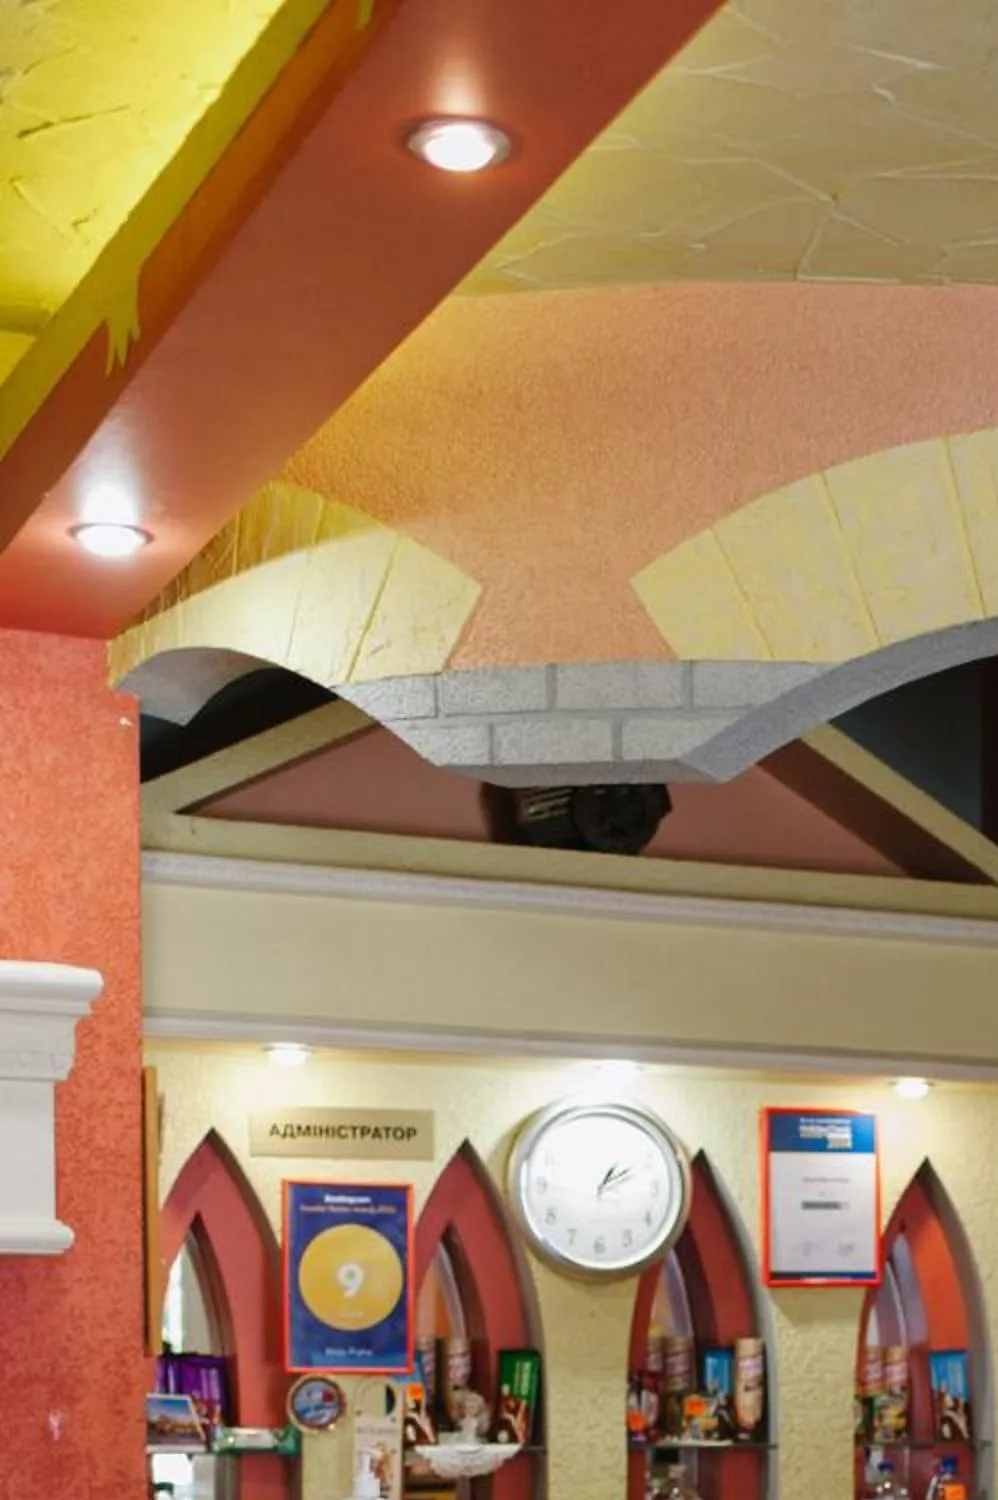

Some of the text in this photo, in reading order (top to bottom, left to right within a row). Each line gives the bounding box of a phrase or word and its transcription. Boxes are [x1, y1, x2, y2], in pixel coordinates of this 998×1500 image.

[269, 1123, 418, 1141] АДМІНІСТРАТОР
[567, 1228, 578, 1246] 7
[593, 1236, 607, 1254] 6
[621, 1229, 634, 1248] 5
[337, 1262, 364, 1298] 9
